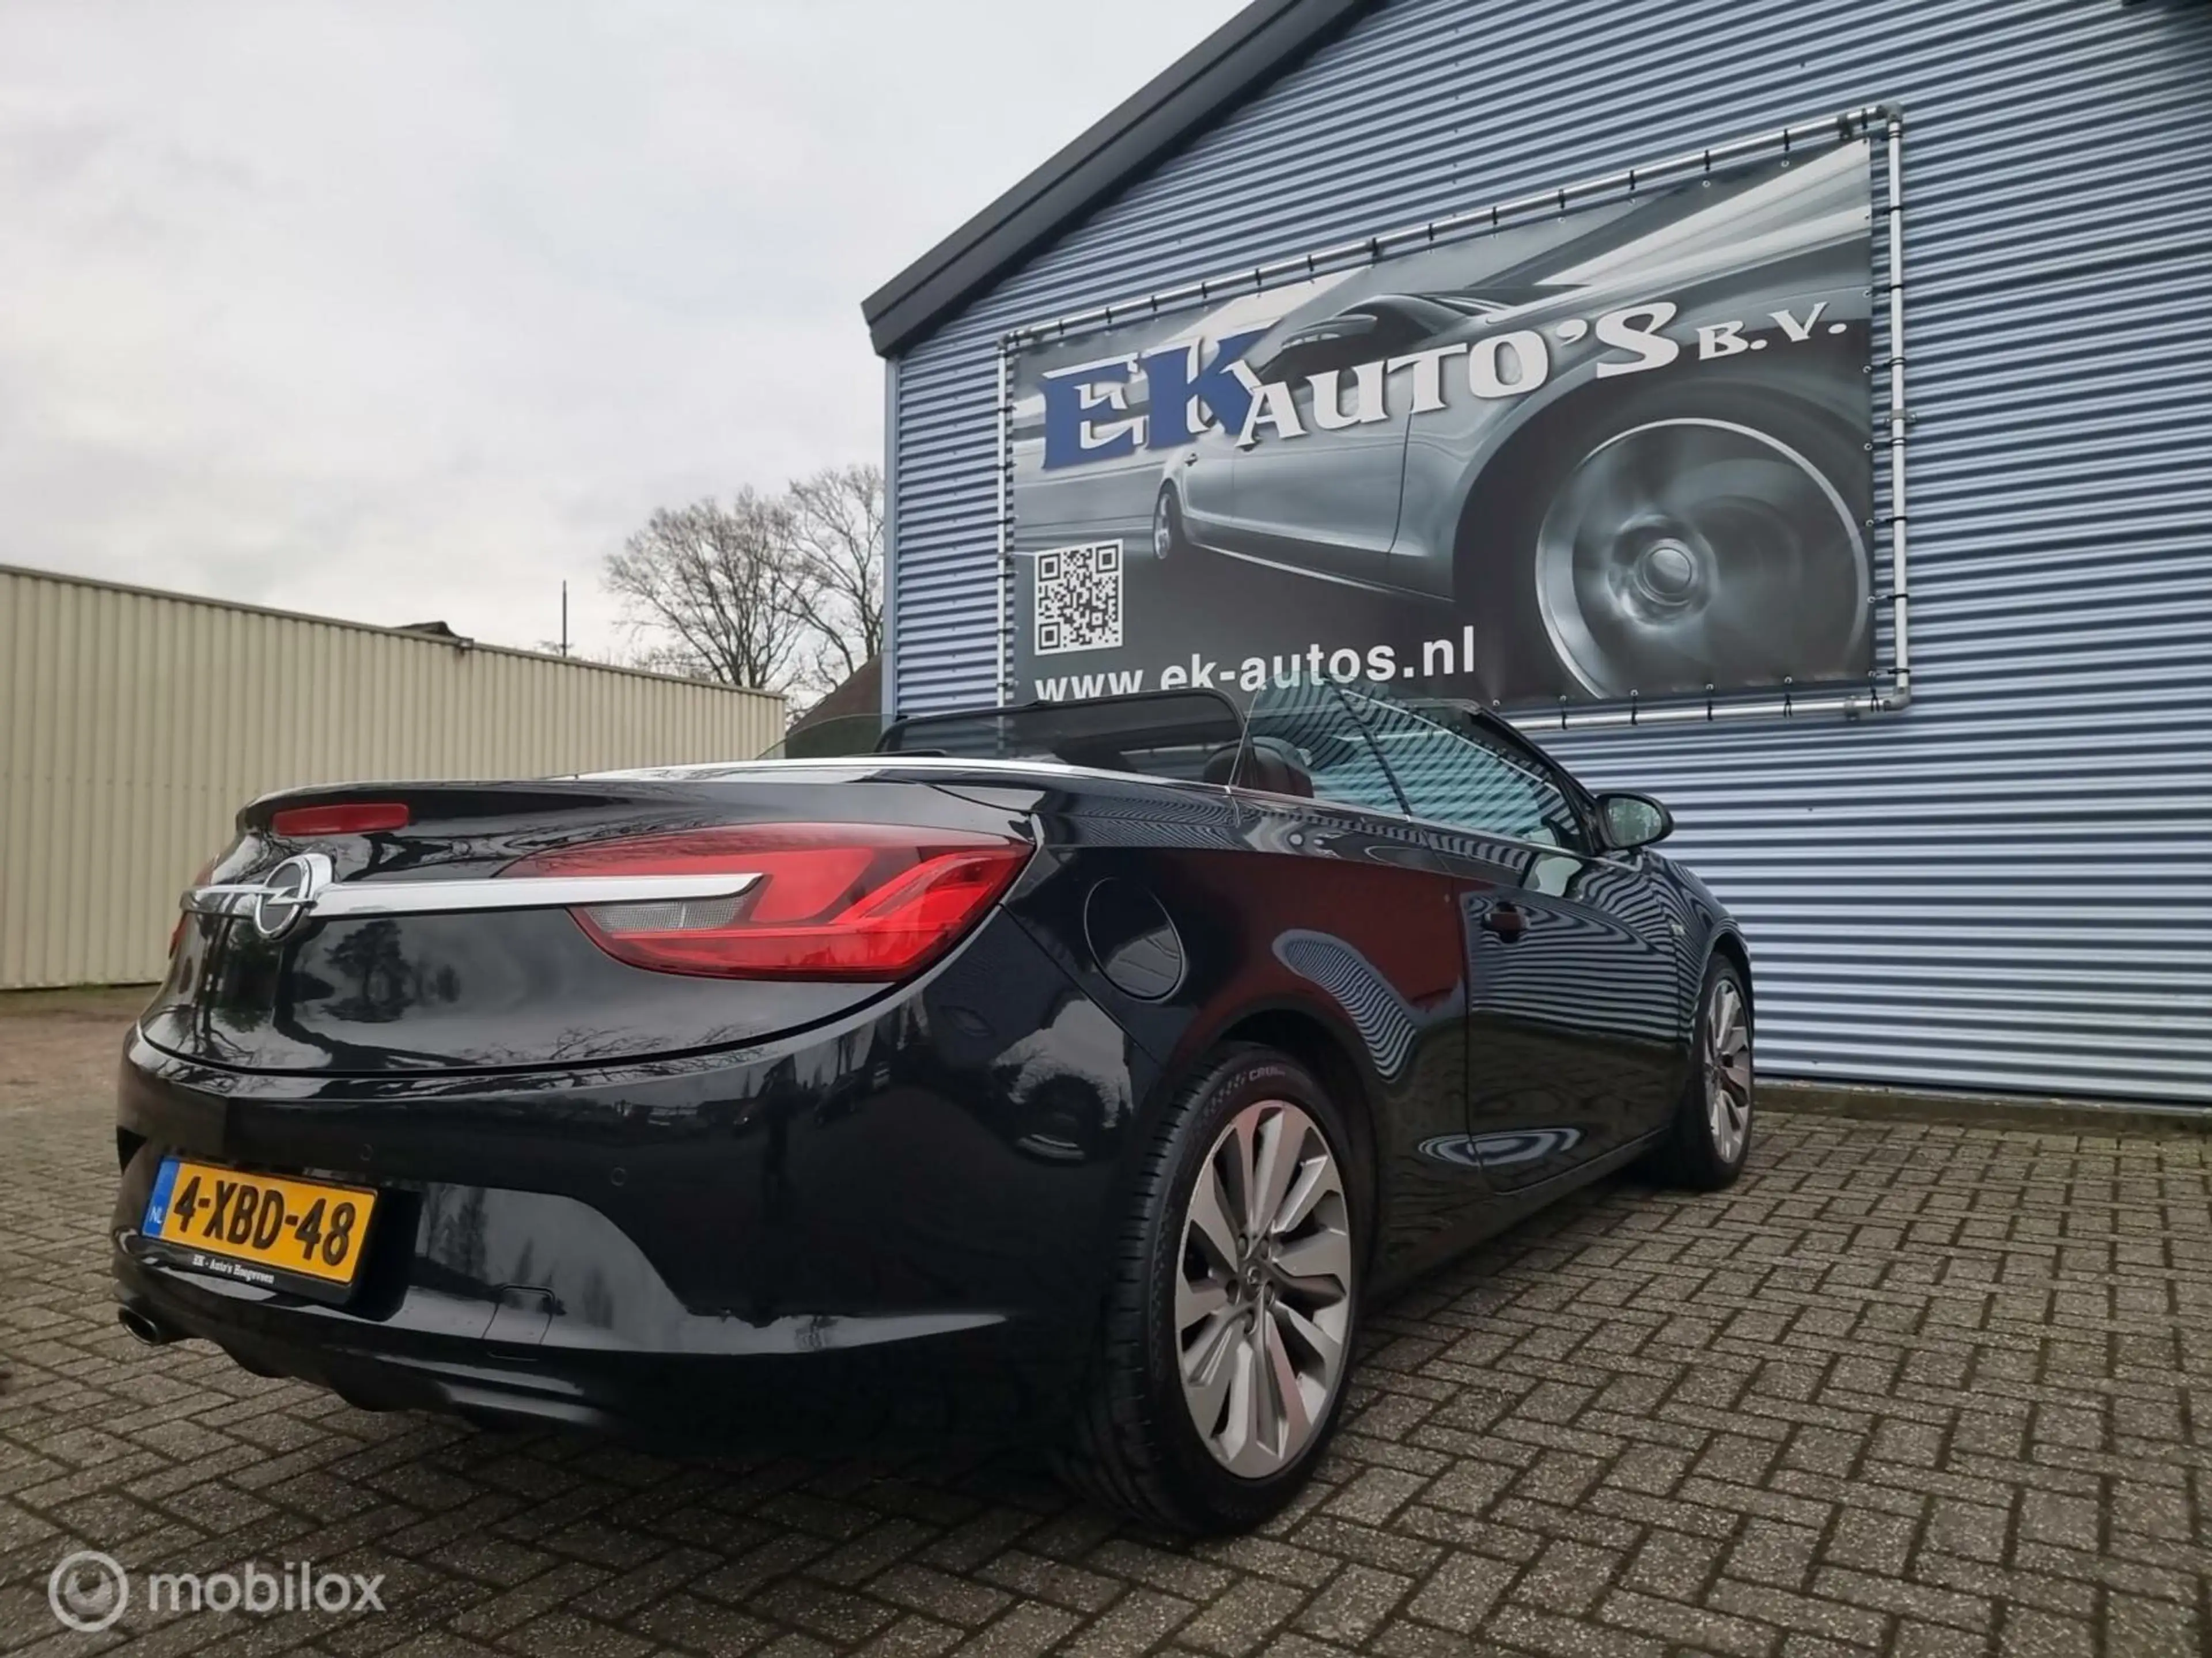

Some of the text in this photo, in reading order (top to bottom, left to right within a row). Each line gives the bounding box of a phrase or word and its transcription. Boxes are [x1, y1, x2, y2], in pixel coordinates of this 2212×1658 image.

[1041, 318, 1281, 469] EK
[1697, 301, 1848, 361] B.V.
[149, 1206, 162, 1224] NL
[173, 1176, 356, 1266] 4-XBD-48
